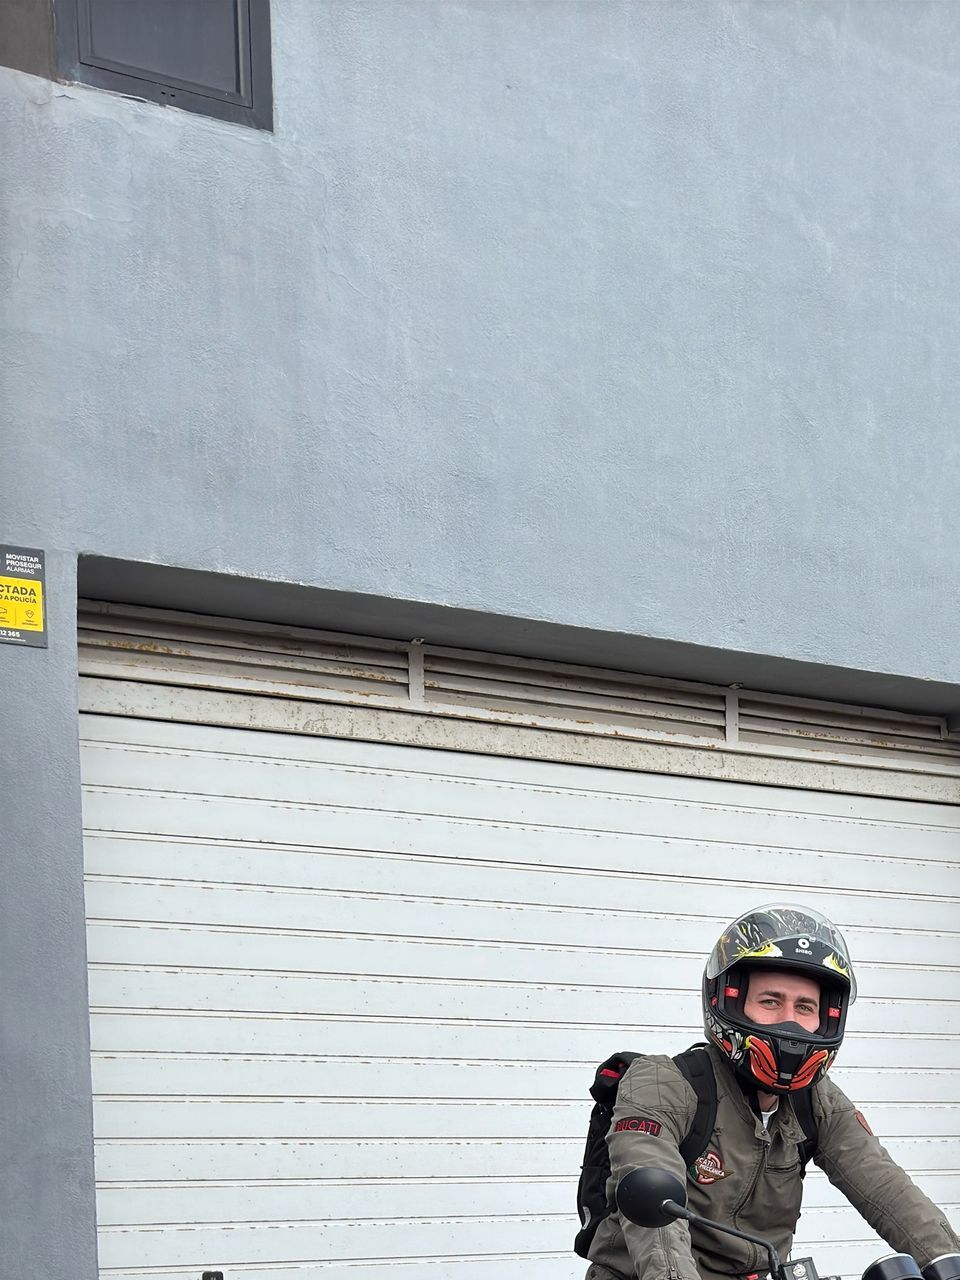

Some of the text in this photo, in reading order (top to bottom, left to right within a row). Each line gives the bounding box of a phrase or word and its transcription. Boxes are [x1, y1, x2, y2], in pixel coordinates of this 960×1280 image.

[5, 553, 39, 563] MOVISTAR
[5, 559, 42, 569] PROSEGUR
[6, 565, 35, 575] ALARMAS
